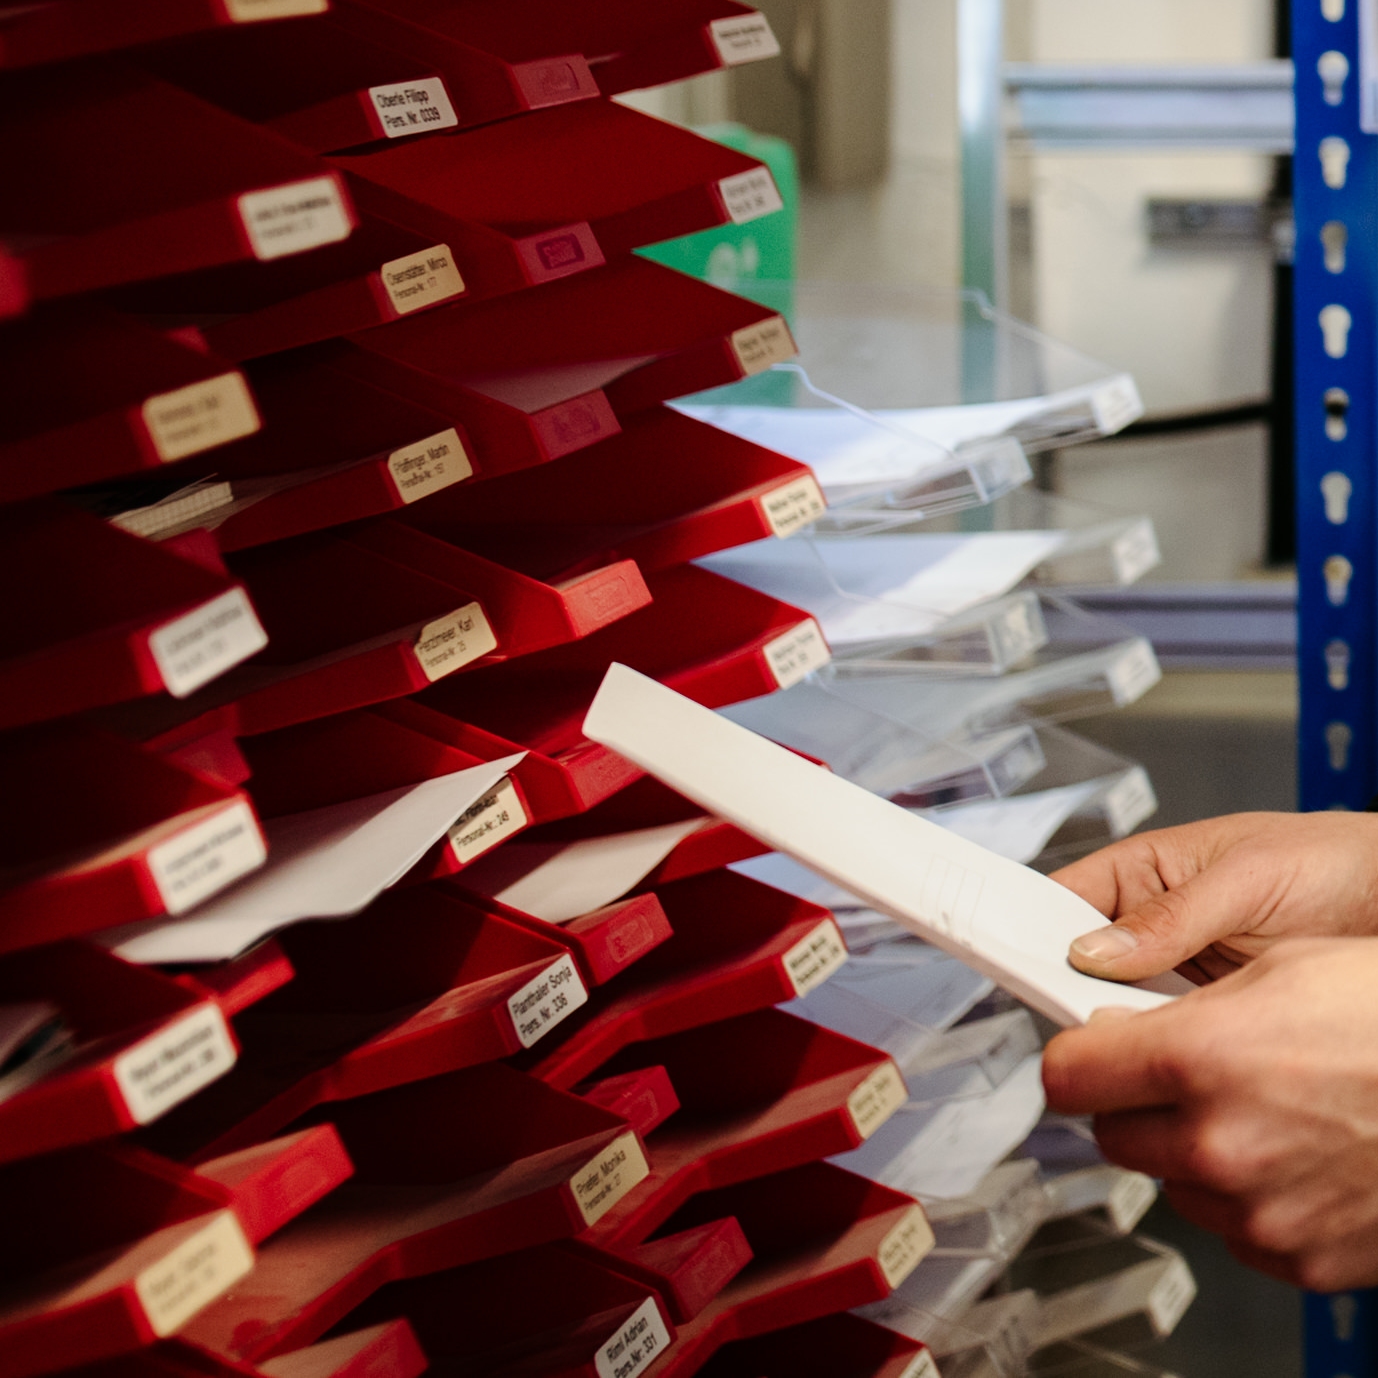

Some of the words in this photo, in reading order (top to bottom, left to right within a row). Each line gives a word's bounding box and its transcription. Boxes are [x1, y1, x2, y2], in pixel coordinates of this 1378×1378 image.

[376, 92, 405, 108] Oberle
[404, 88, 428, 104] Filipp
[384, 115, 407, 128] Pers.
[548, 966, 572, 989] Sonja
[519, 1018, 541, 1039] Pers.
[600, 1150, 626, 1177] Monika
[624, 1316, 649, 1346] Adrian
[642, 1331, 658, 1354] 331
